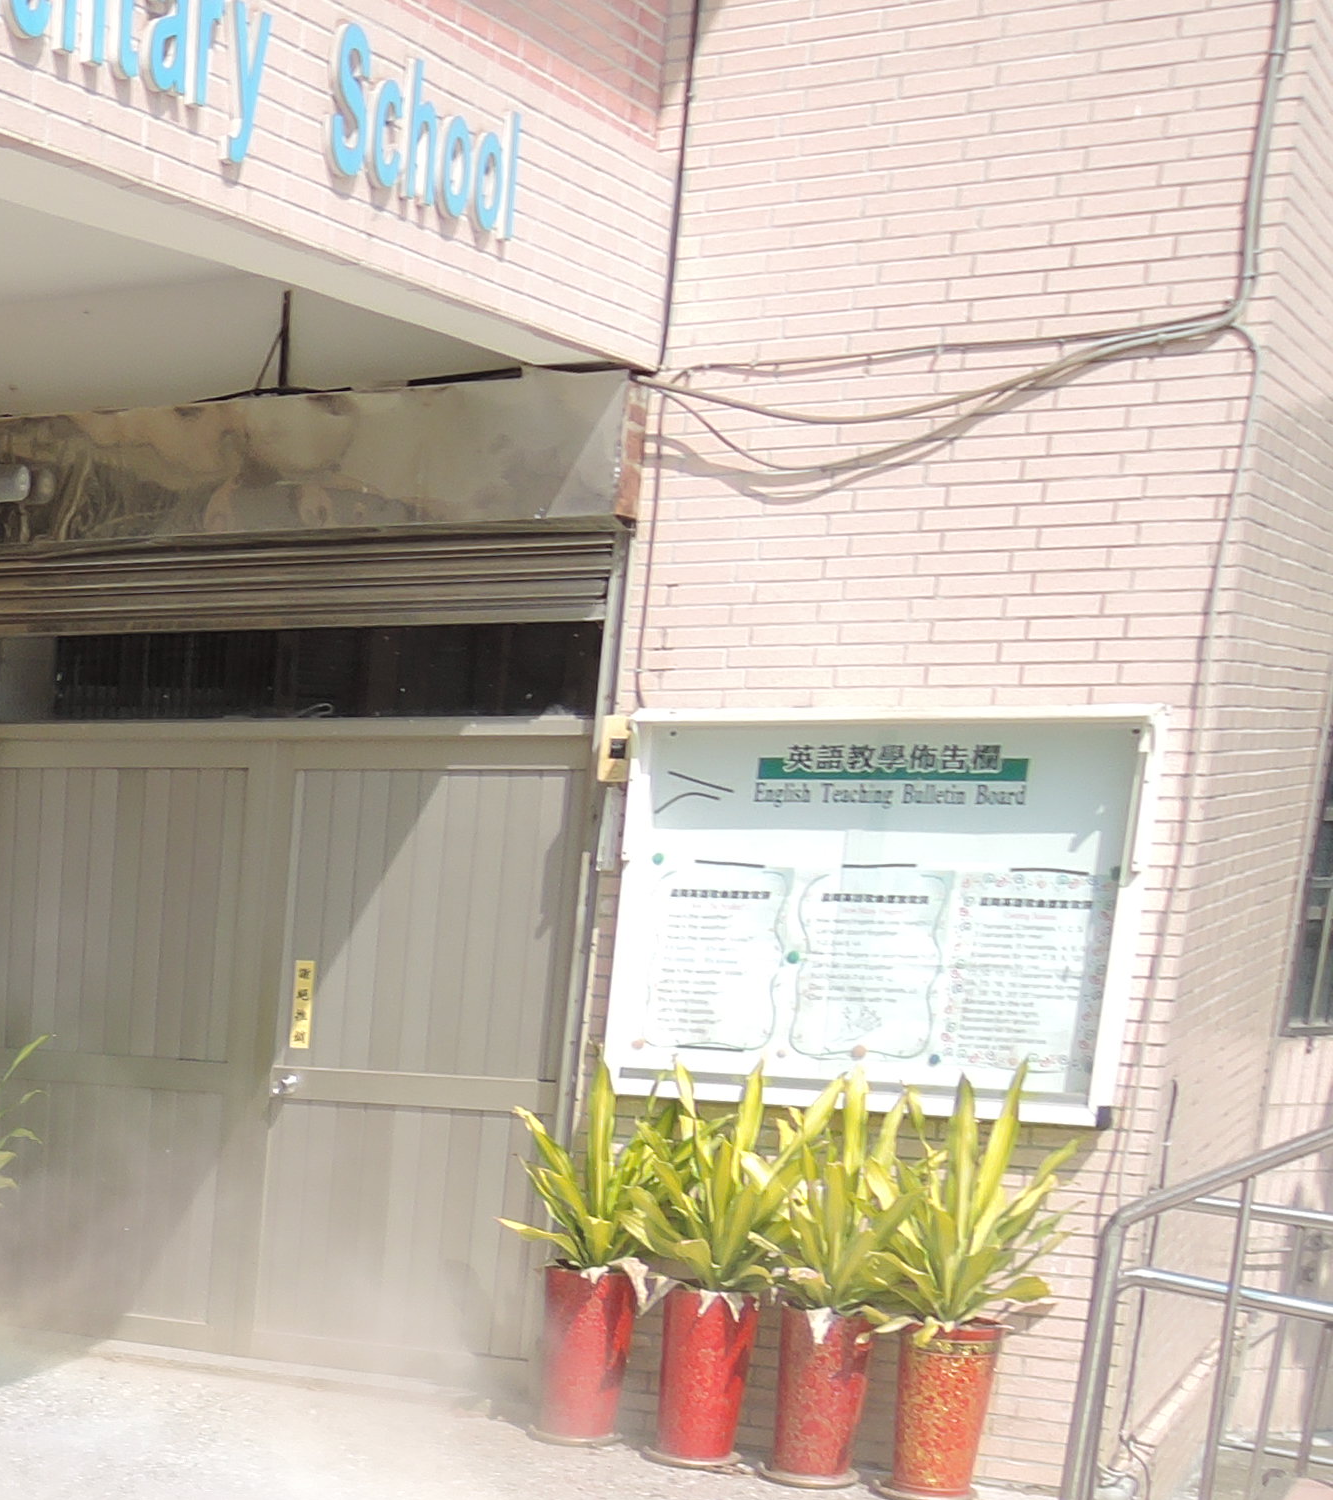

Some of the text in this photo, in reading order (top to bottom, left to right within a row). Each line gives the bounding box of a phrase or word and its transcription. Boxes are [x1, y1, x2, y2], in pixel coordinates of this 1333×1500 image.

[324, 20, 522, 241] School
[784, 744, 1002, 773] 英語教學佈告欄
[753, 782, 1027, 809] English Teaching Bulletin Board
